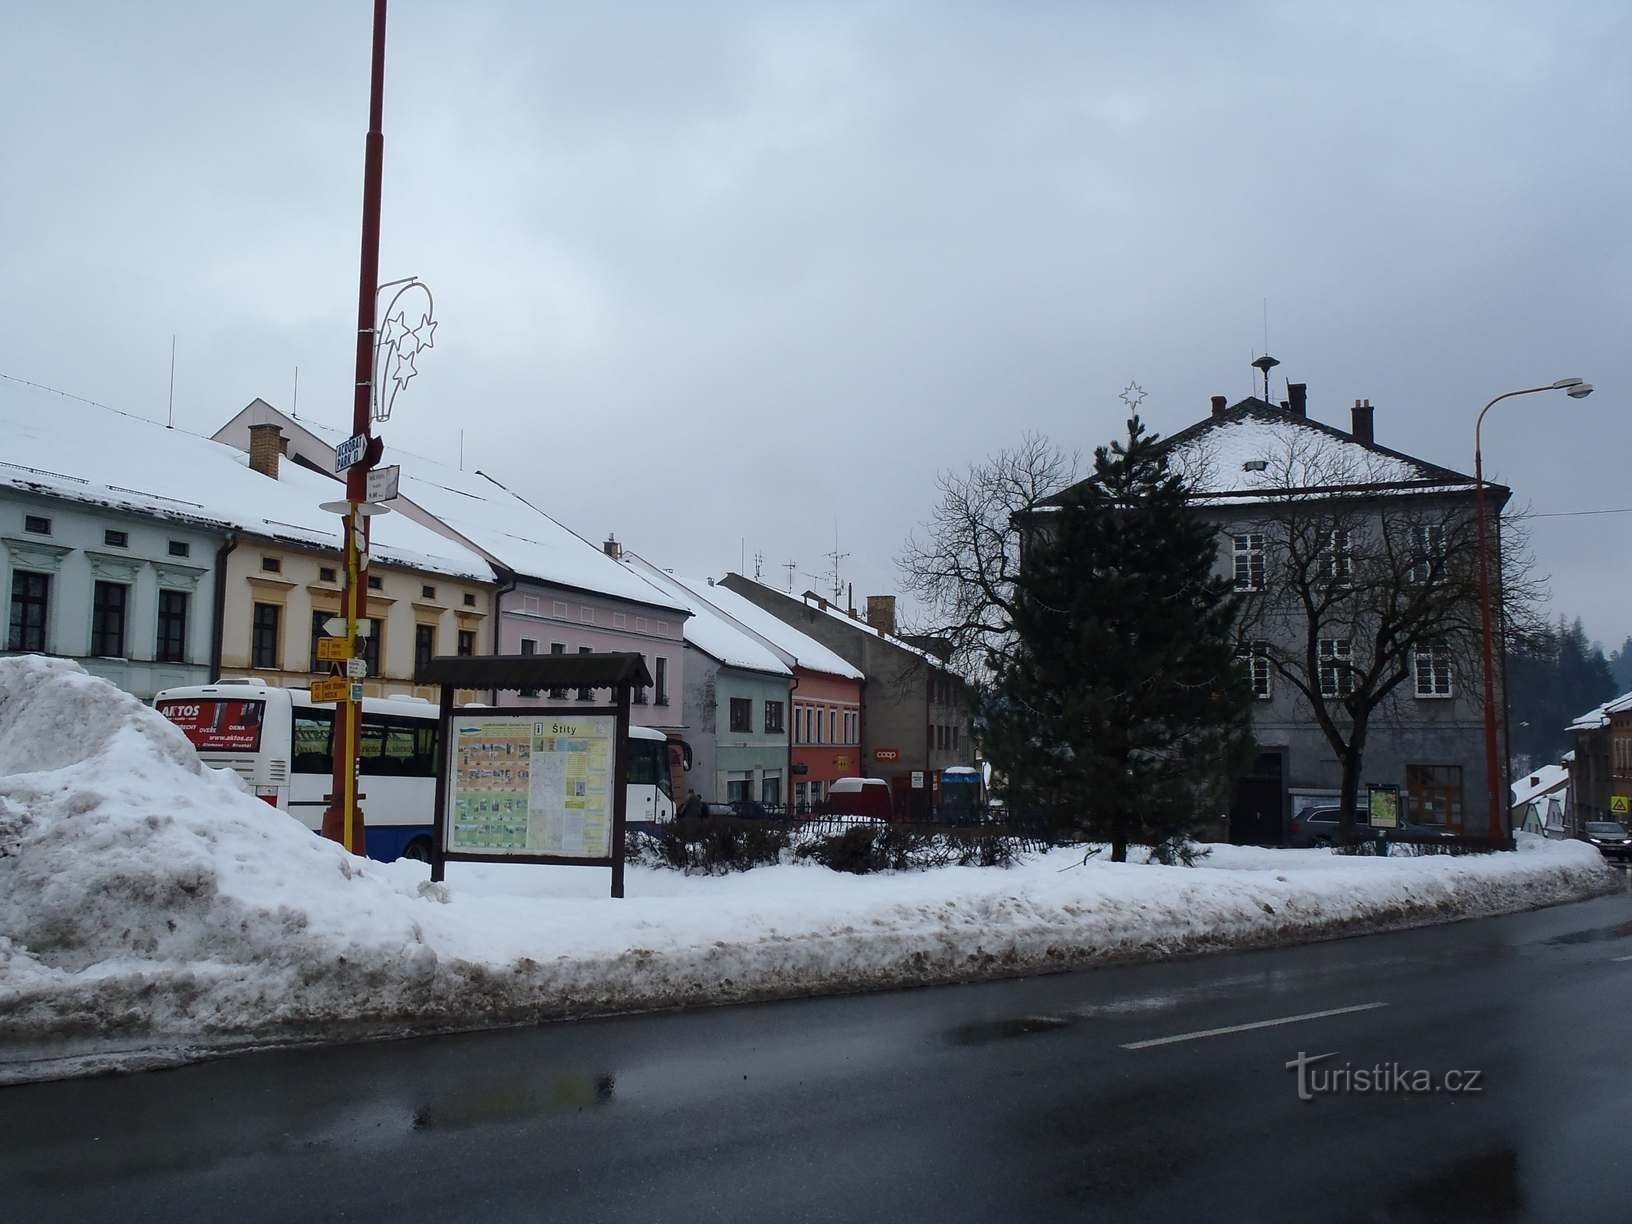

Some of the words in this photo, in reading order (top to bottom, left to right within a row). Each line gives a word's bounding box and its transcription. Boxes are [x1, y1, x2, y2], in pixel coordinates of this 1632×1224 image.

[338, 436, 362, 457] ACROBAT
[337, 453, 352, 470] PARK
[162, 705, 200, 717] AKTOS
[876, 751, 897, 759] coop
